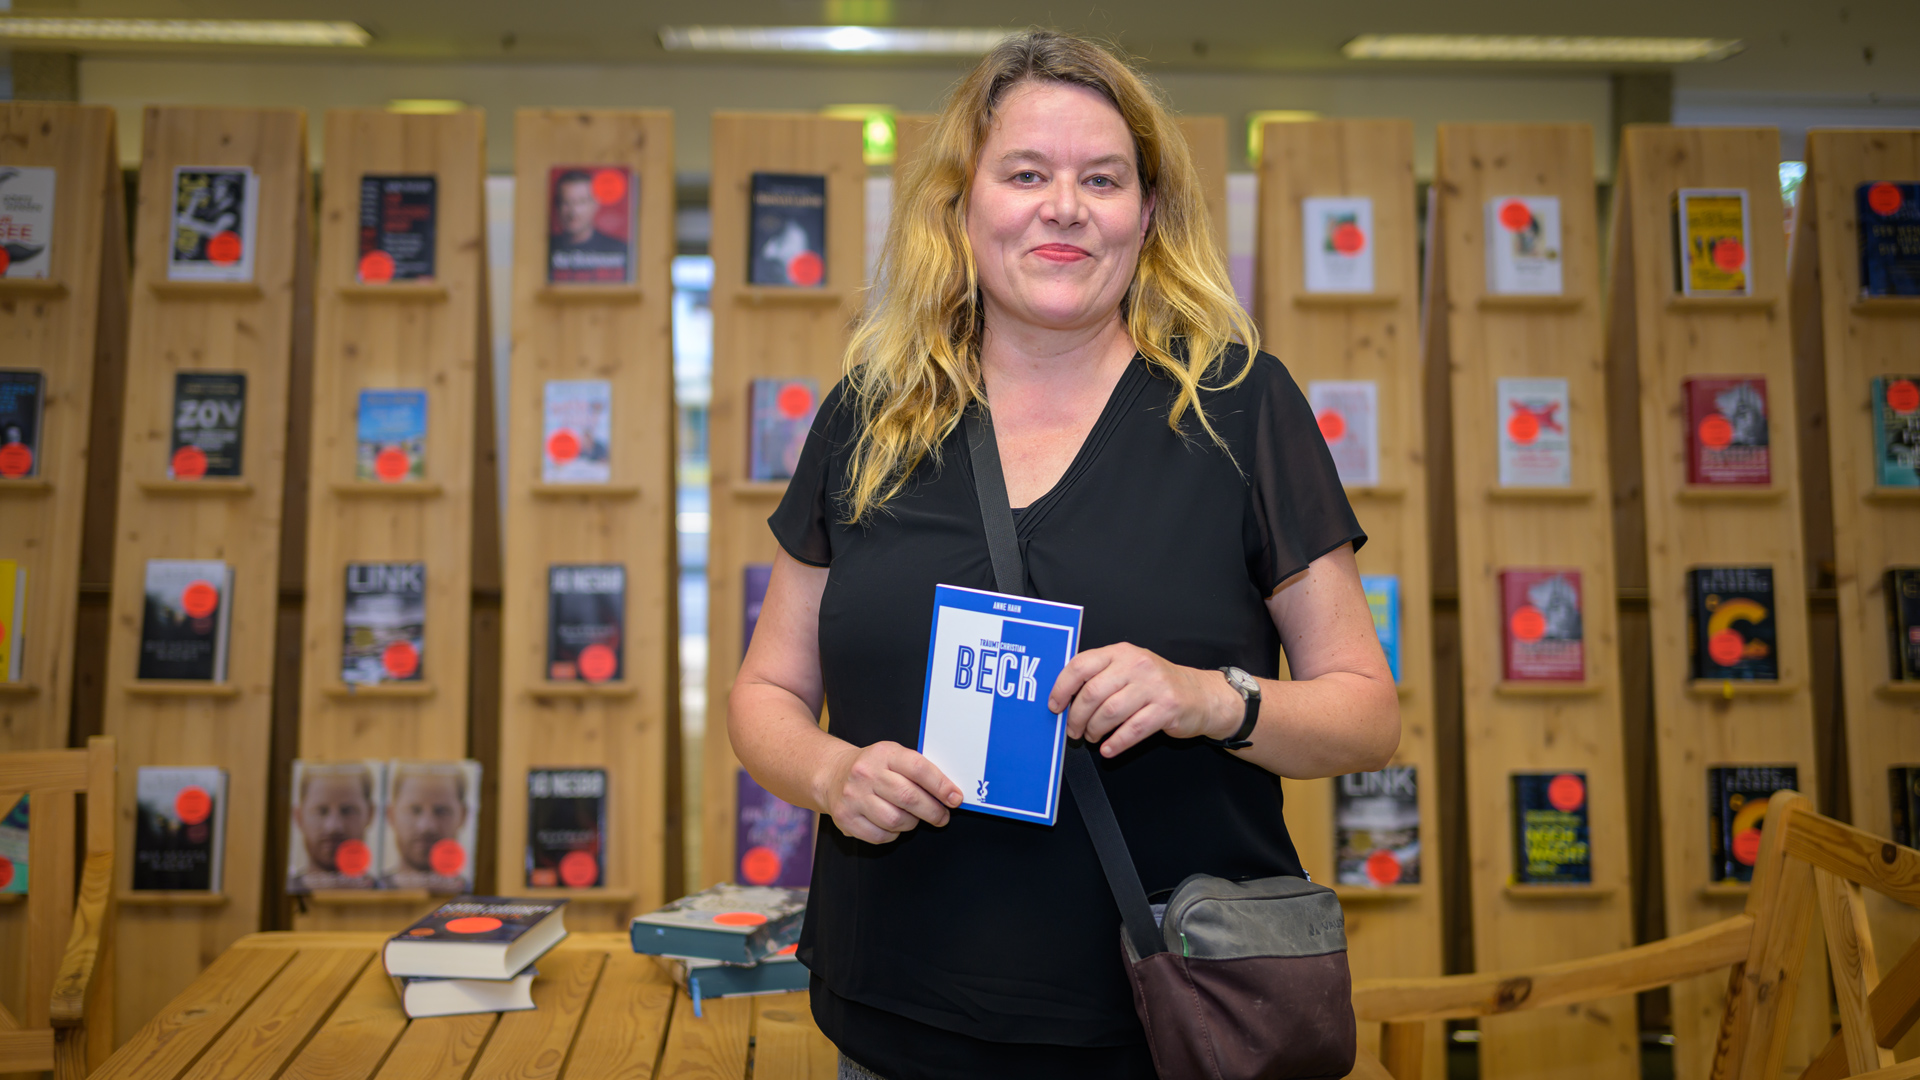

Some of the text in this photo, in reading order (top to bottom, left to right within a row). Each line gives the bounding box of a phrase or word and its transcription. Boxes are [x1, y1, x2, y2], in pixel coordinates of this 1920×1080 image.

[177, 399, 241, 429] ZOV
[348, 562, 422, 594] LINK
[992, 601, 1022, 614] ANNE HAHN
[1000, 641, 1026, 653] CHRISTIAN
[954, 645, 1041, 702] BECK
